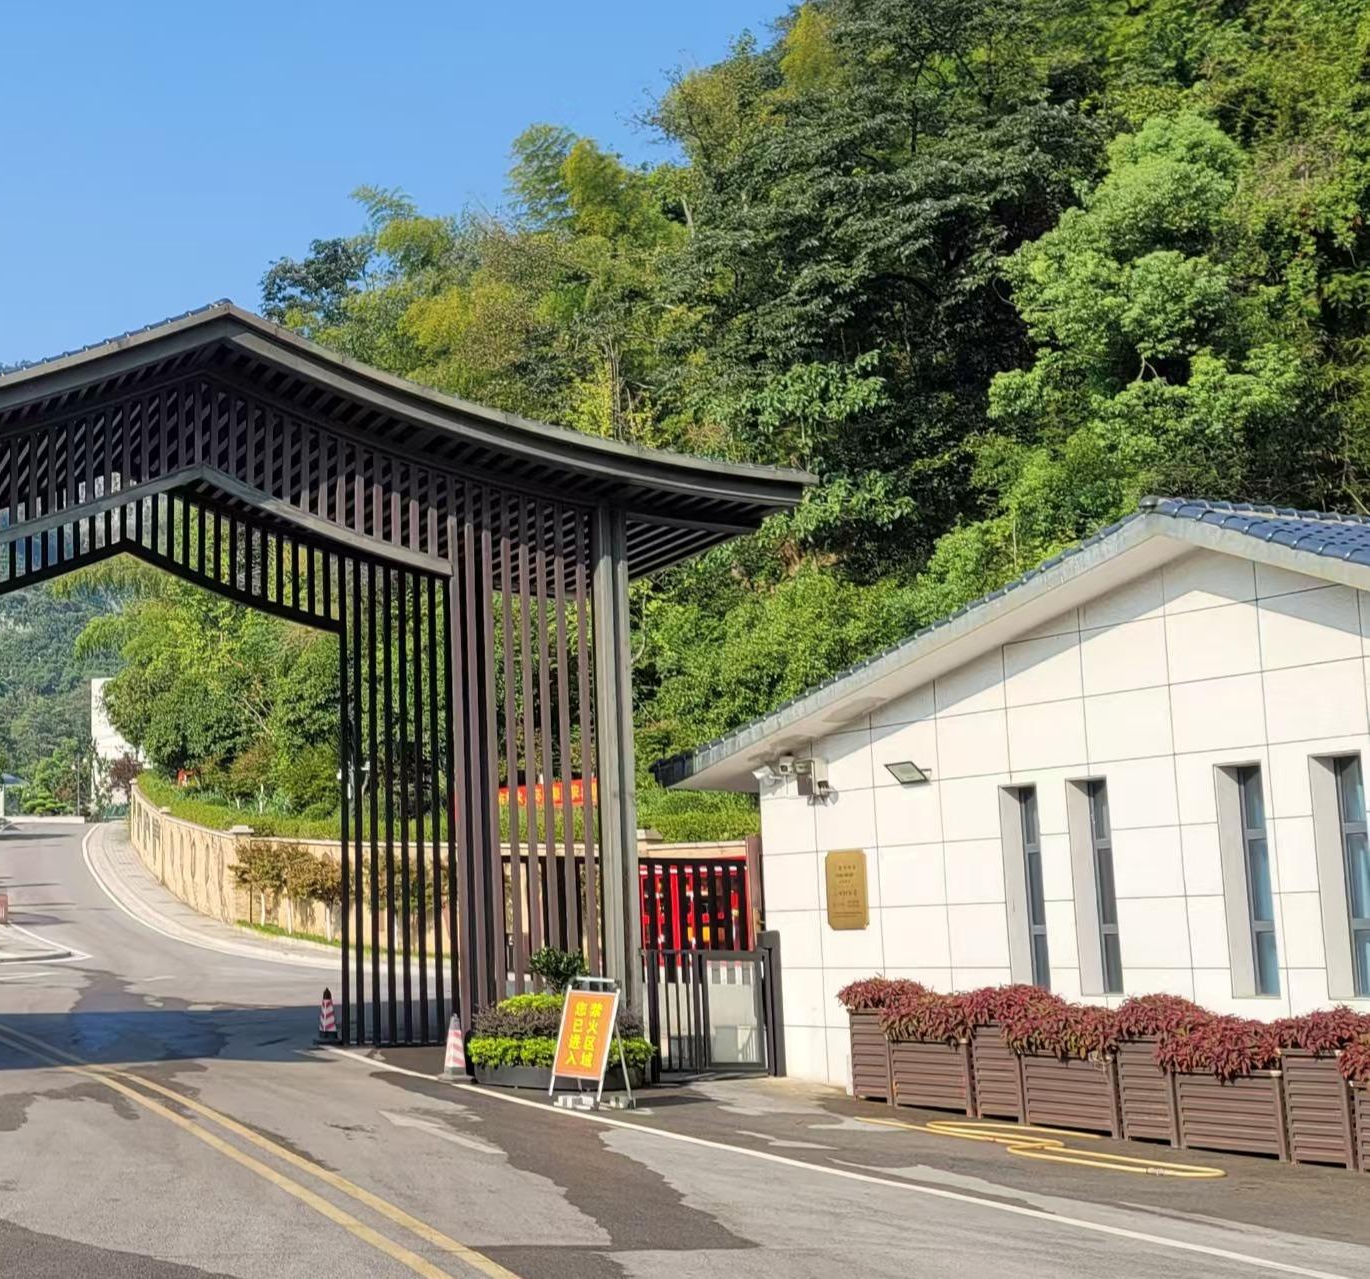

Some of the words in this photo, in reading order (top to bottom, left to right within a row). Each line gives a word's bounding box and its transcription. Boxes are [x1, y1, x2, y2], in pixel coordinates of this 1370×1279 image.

[565, 1001, 588, 1065] 您已进入
[580, 1002, 603, 1068] 禁火区域
